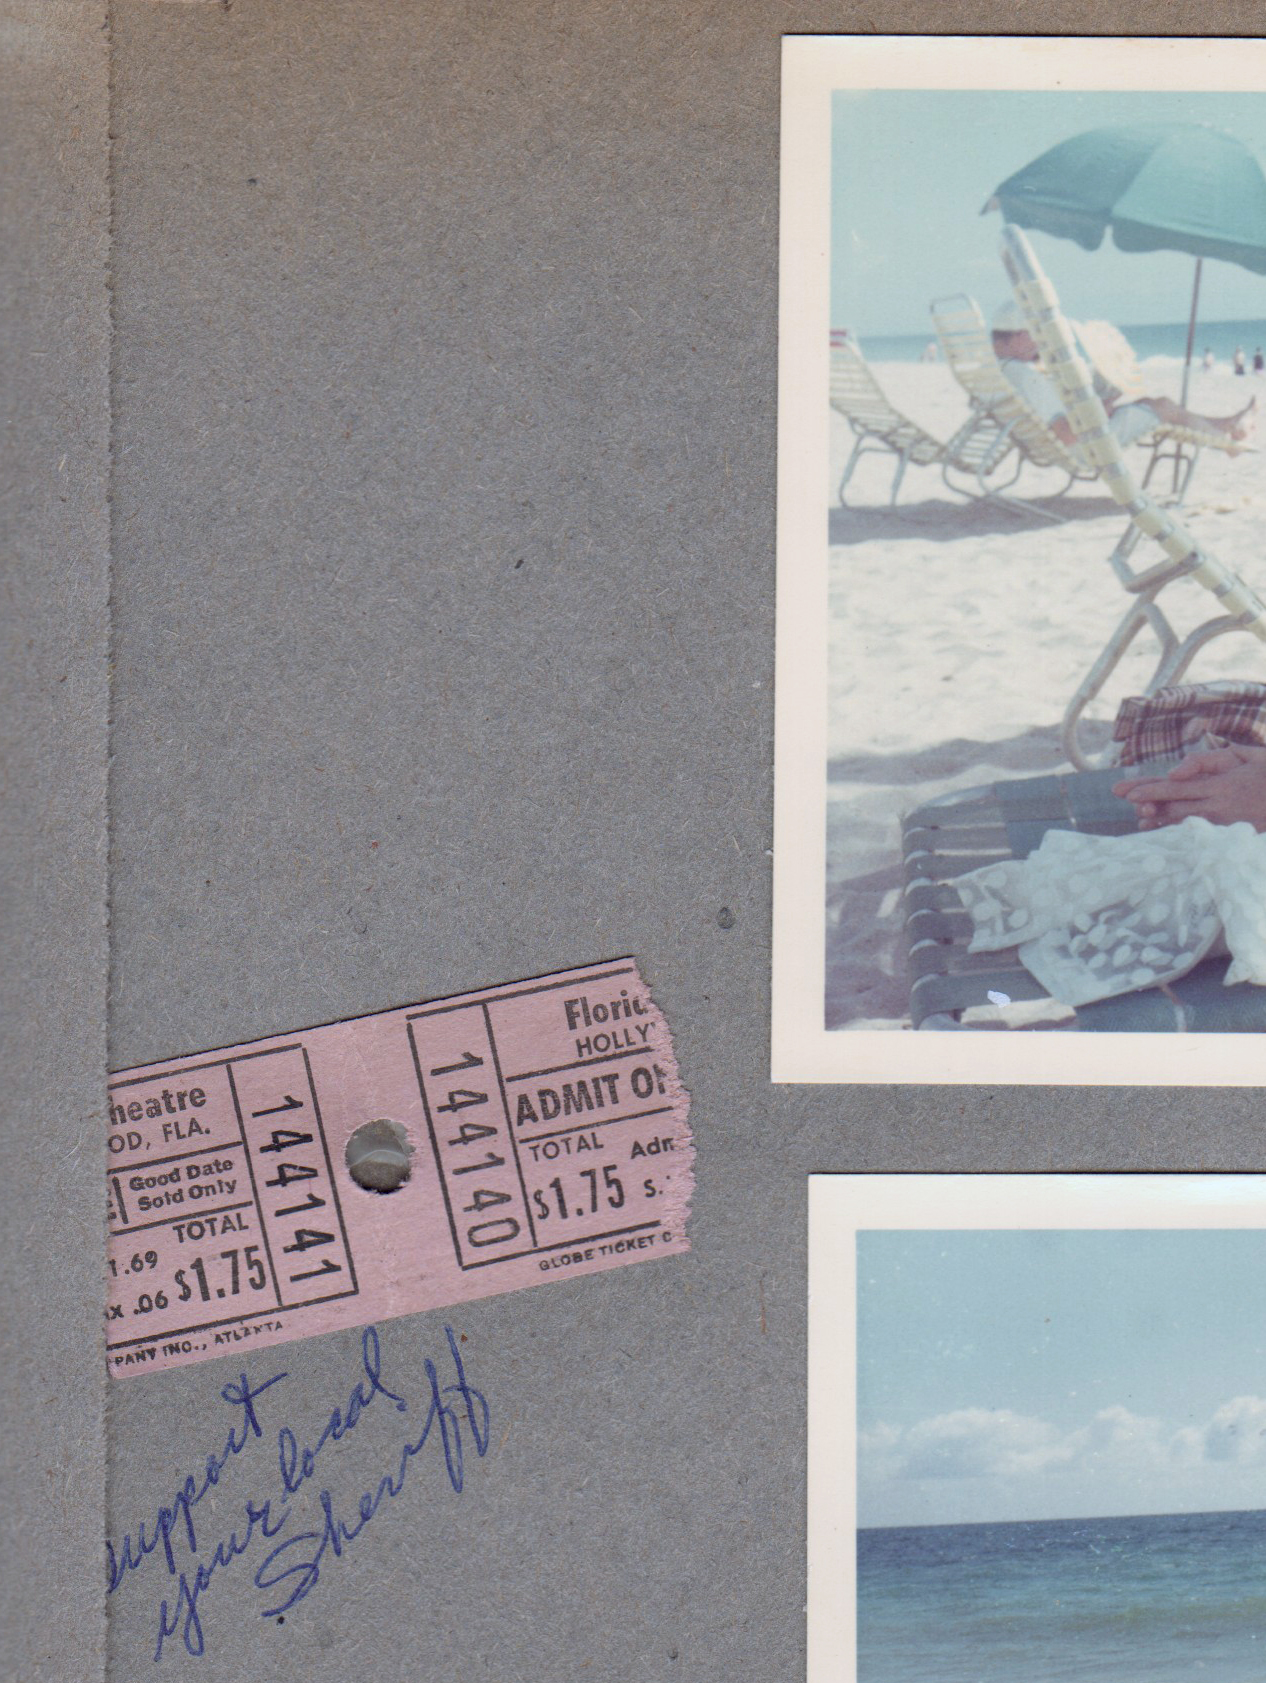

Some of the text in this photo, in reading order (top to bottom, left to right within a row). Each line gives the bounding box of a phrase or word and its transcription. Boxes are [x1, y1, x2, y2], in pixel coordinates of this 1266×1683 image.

[575, 1022, 656, 1058] HOLLY
[517, 1072, 620, 1127] ADMIT
[162, 1117, 211, 1143] FLA.
[529, 1132, 604, 1162] TOTAL
[430, 1051, 520, 1248] 144140
[129, 1159, 234, 1192] Good Date
[252, 1094, 342, 1284] 144141
[533, 1164, 625, 1220] $1.75
[138, 1188, 184, 1212] Sold
[188, 1179, 237, 1200] Only
[172, 1212, 249, 1243] TOTAL
[539, 1248, 596, 1271] GLOBE
[598, 1234, 656, 1257] TICKET
[174, 1244, 266, 1302] $1.75
[133, 1290, 169, 1316] .06
[277, 1325, 408, 1505] local
